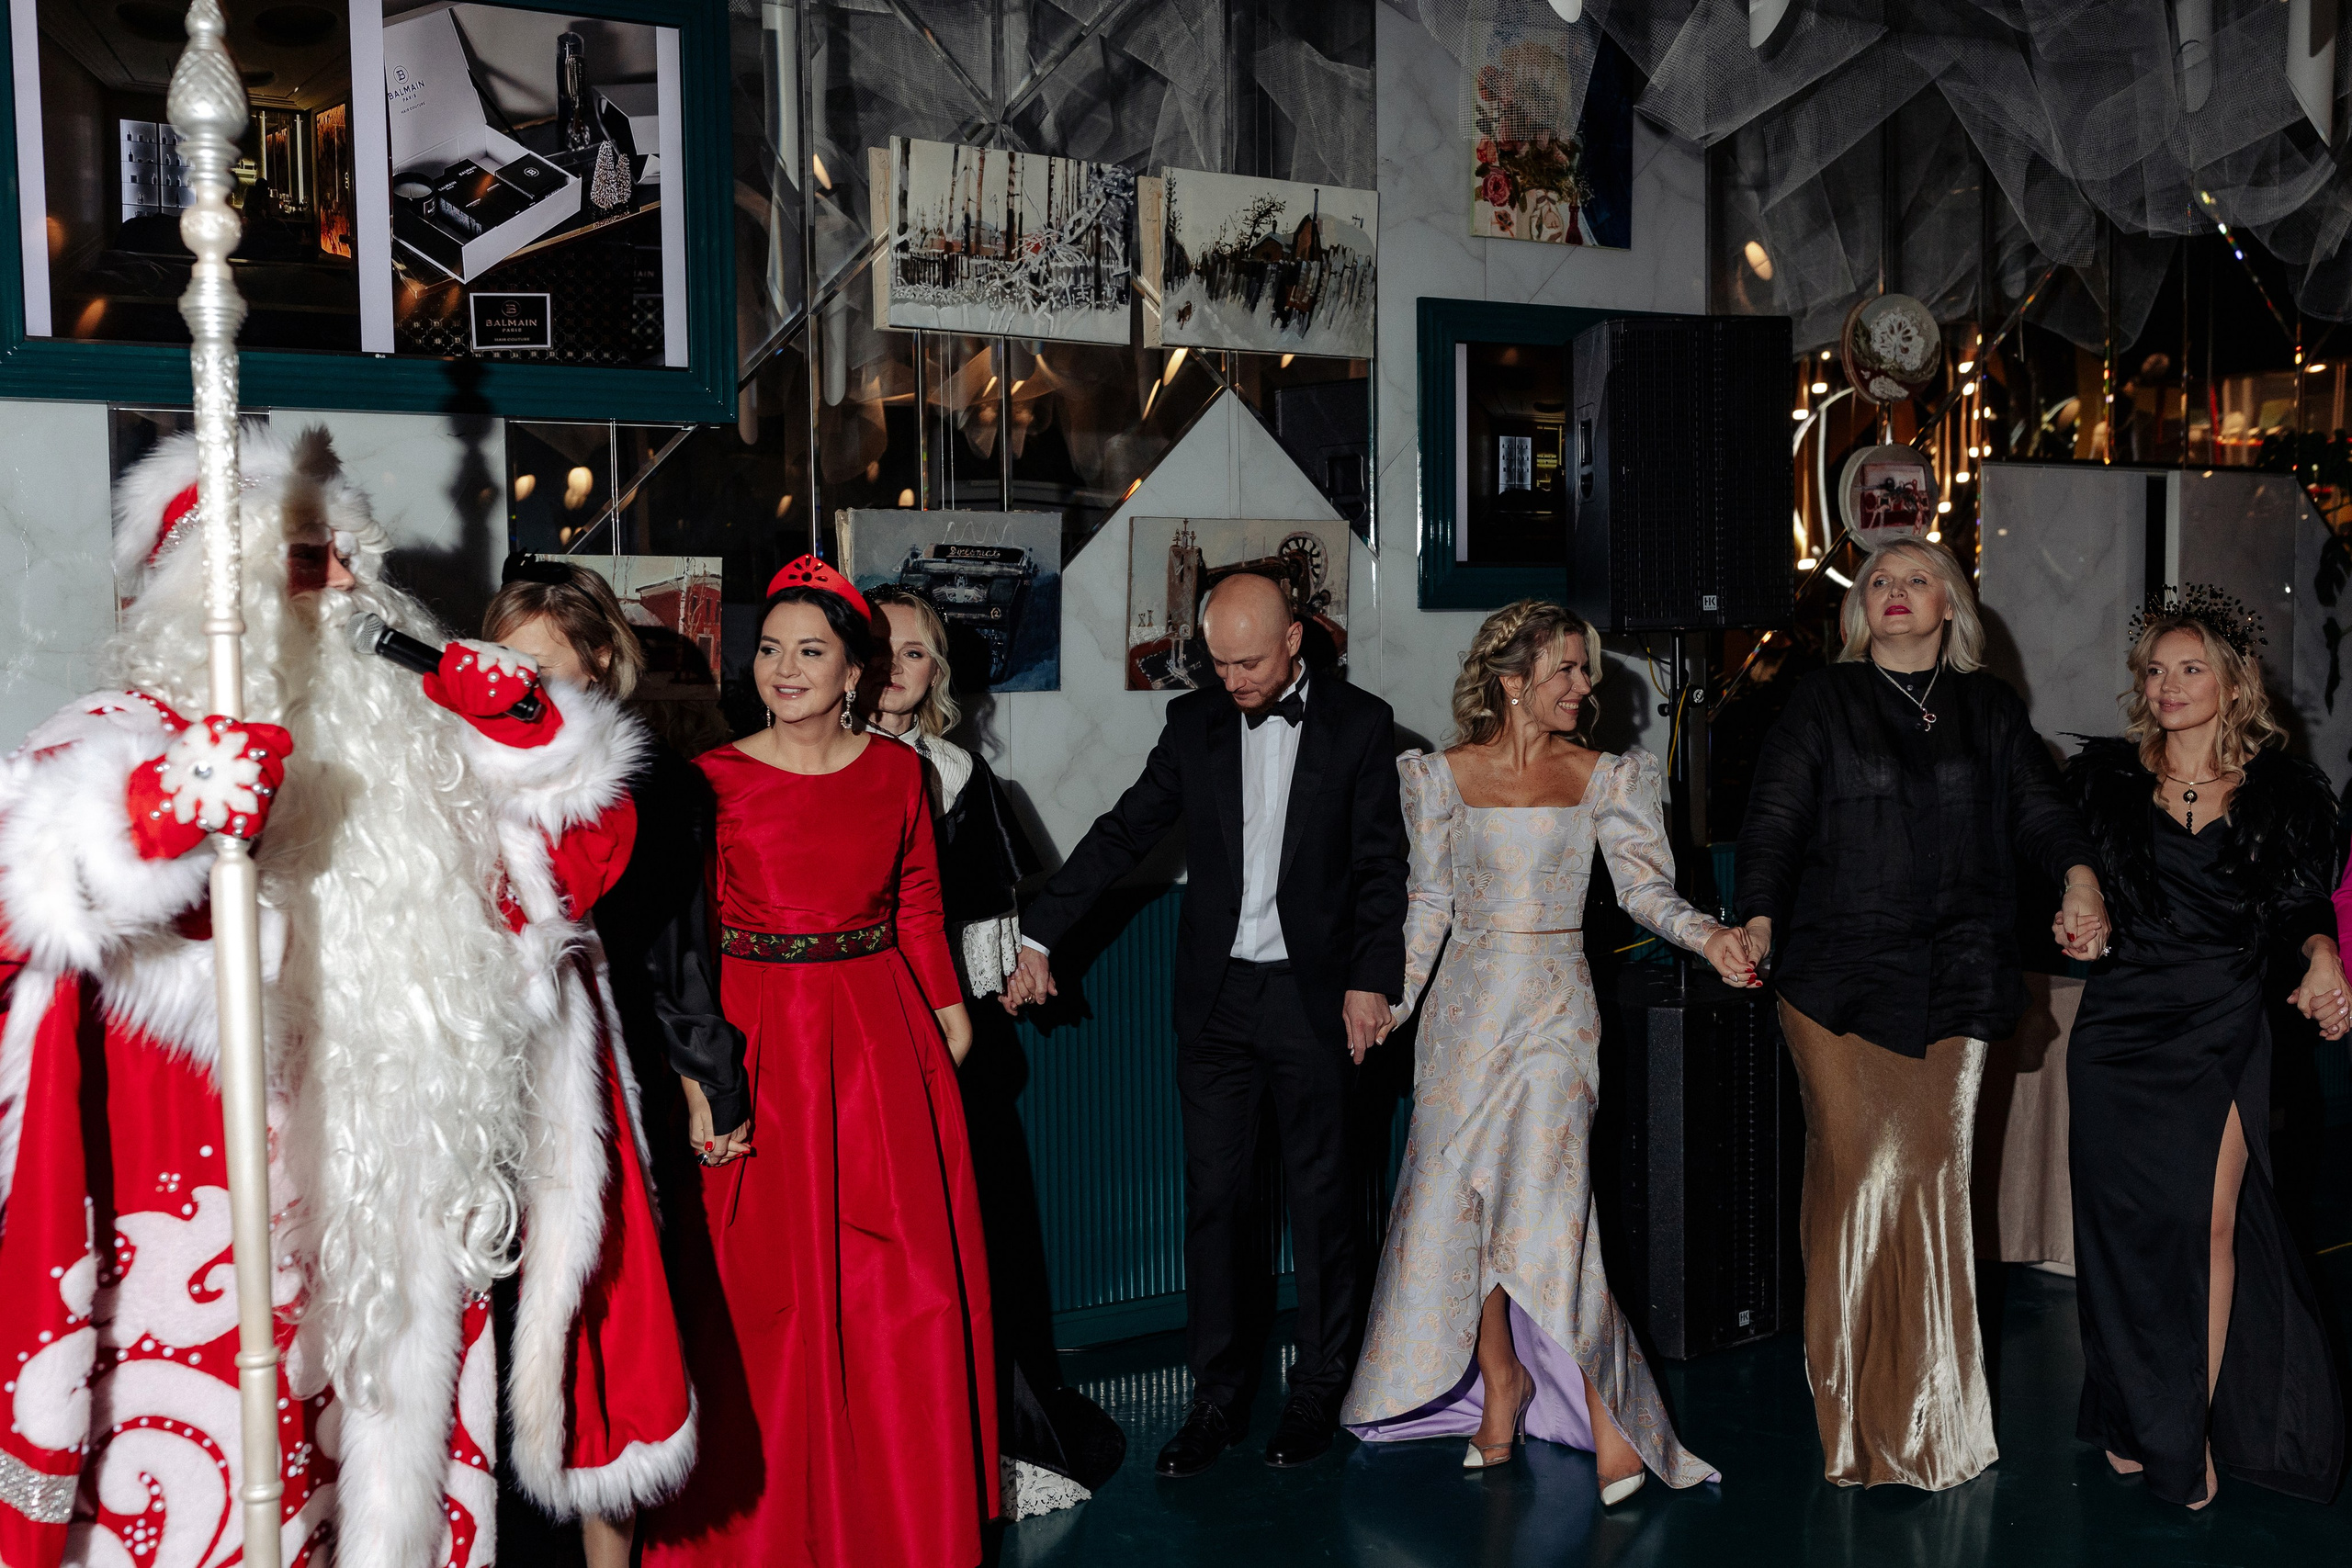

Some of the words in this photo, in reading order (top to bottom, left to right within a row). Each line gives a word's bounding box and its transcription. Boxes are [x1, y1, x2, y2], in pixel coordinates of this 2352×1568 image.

[388, 80, 424, 100] BALMAIN
[402, 94, 417, 102] PARIS
[485, 319, 537, 327] BALMAIN
[1705, 597, 1716, 606] HK
[1740, 1312, 1748, 1322] HK
